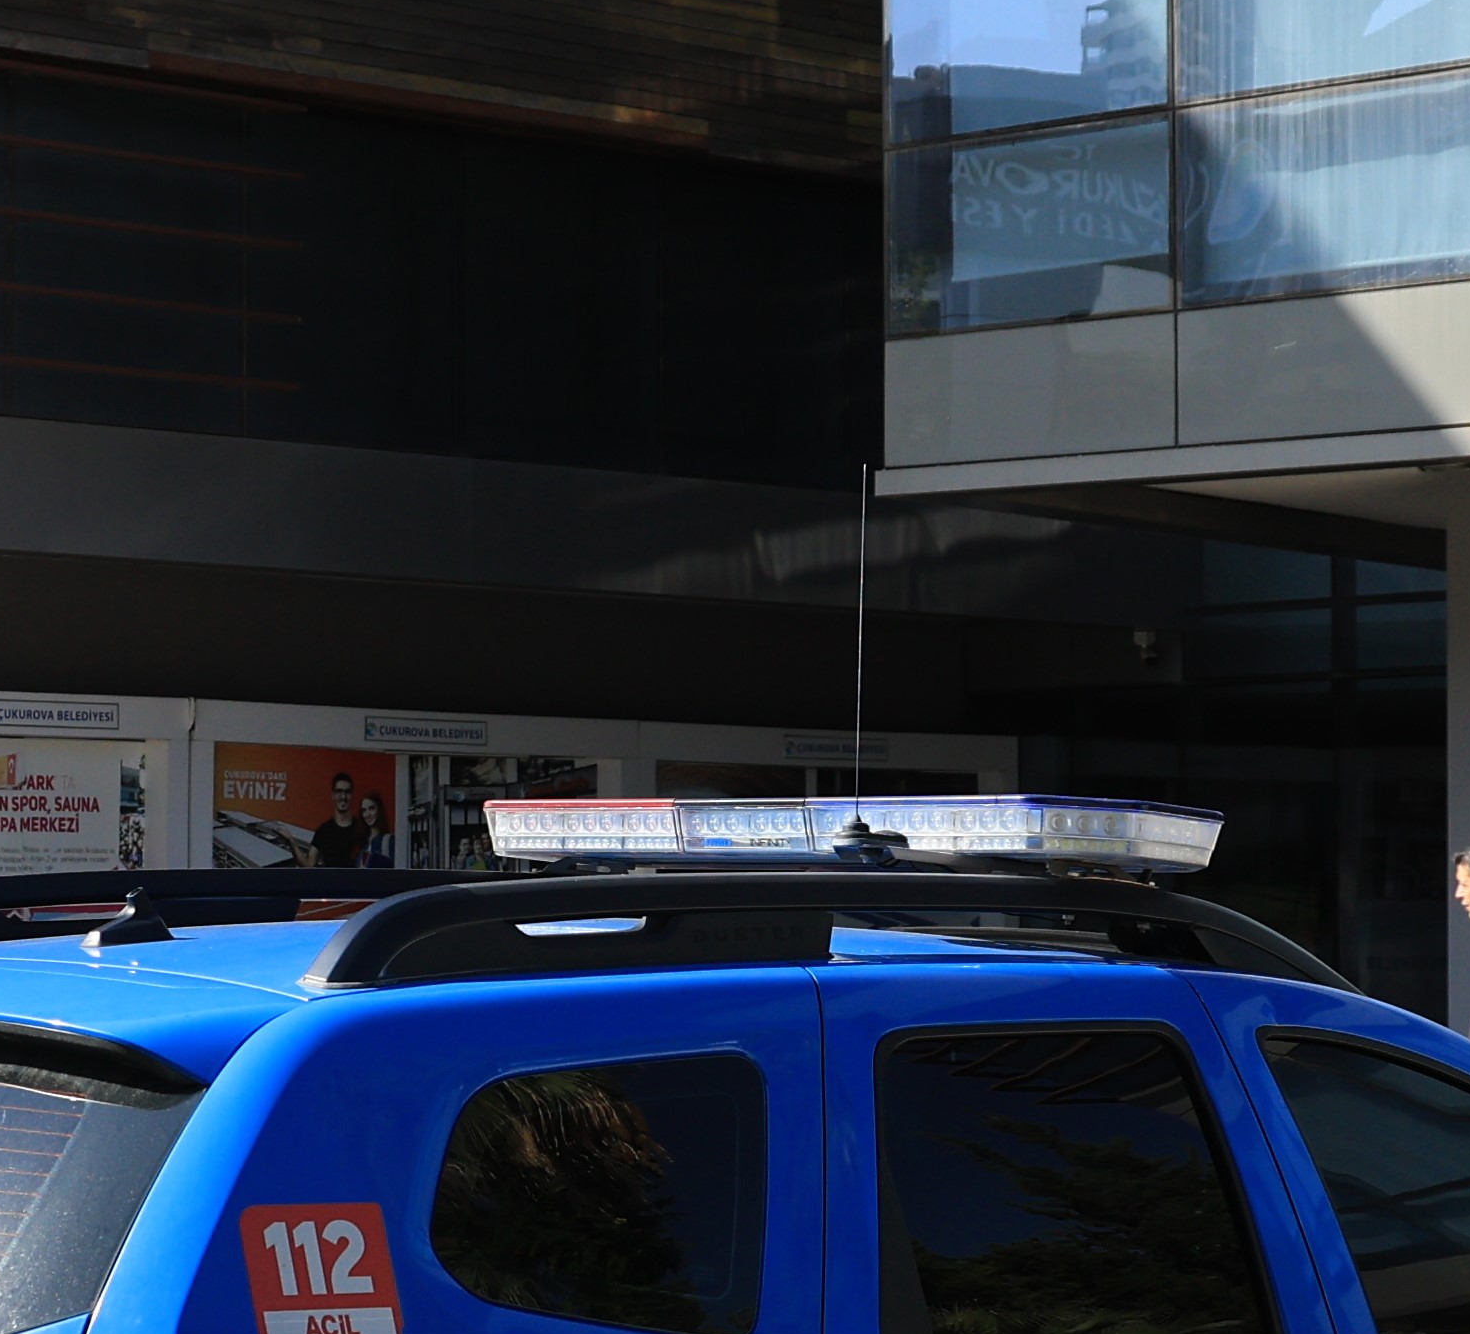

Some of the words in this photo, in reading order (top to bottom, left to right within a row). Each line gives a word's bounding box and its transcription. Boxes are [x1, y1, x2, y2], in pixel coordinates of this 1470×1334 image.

[57, 709, 114, 723] BELEDİYESİ
[379, 725, 430, 738] ÇUKUROVA
[11, 796, 51, 815] SPOR,
[54, 796, 100, 813] SAUNA
[19, 813, 80, 834] MERKEZİ
[263, 1219, 375, 1296] 112
